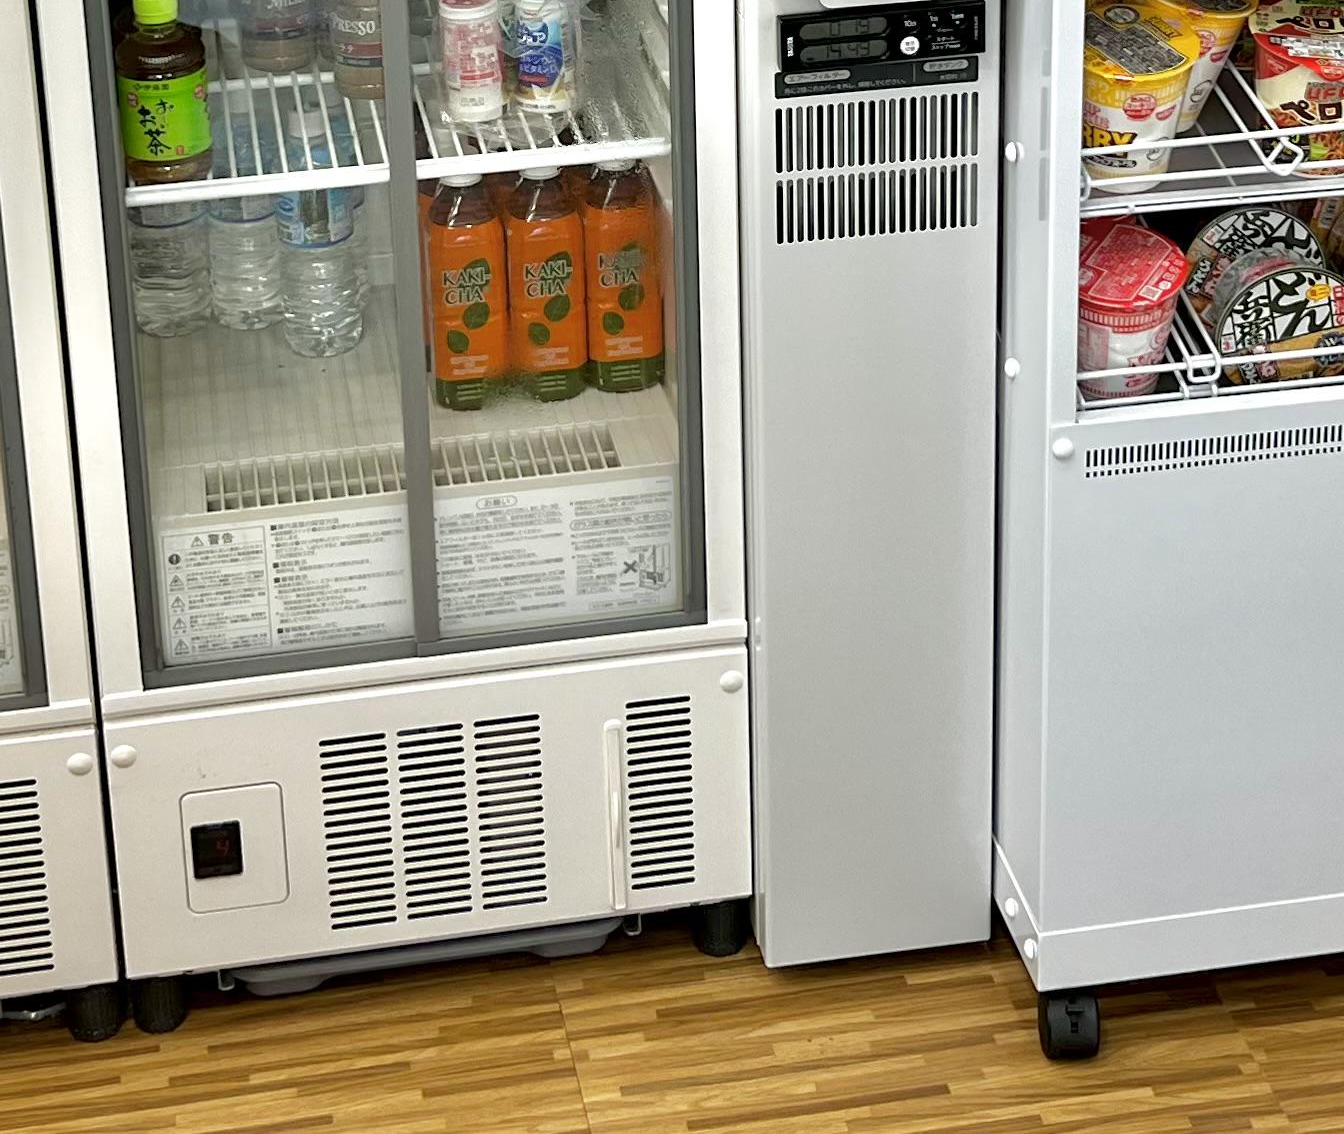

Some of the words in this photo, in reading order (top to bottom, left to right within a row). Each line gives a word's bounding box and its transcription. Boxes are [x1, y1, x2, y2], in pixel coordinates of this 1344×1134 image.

[137, 103, 172, 157] お茶
[443, 266, 493, 288] KAKI-
[523, 259, 573, 281] KAKI-
[599, 269, 640, 289] CHA
[444, 285, 485, 307] CHA
[524, 278, 565, 300] CHA
[1269, 269, 1332, 339] どん
[483, 498, 513, 508] お願い
[207, 532, 235, 546] 警告
